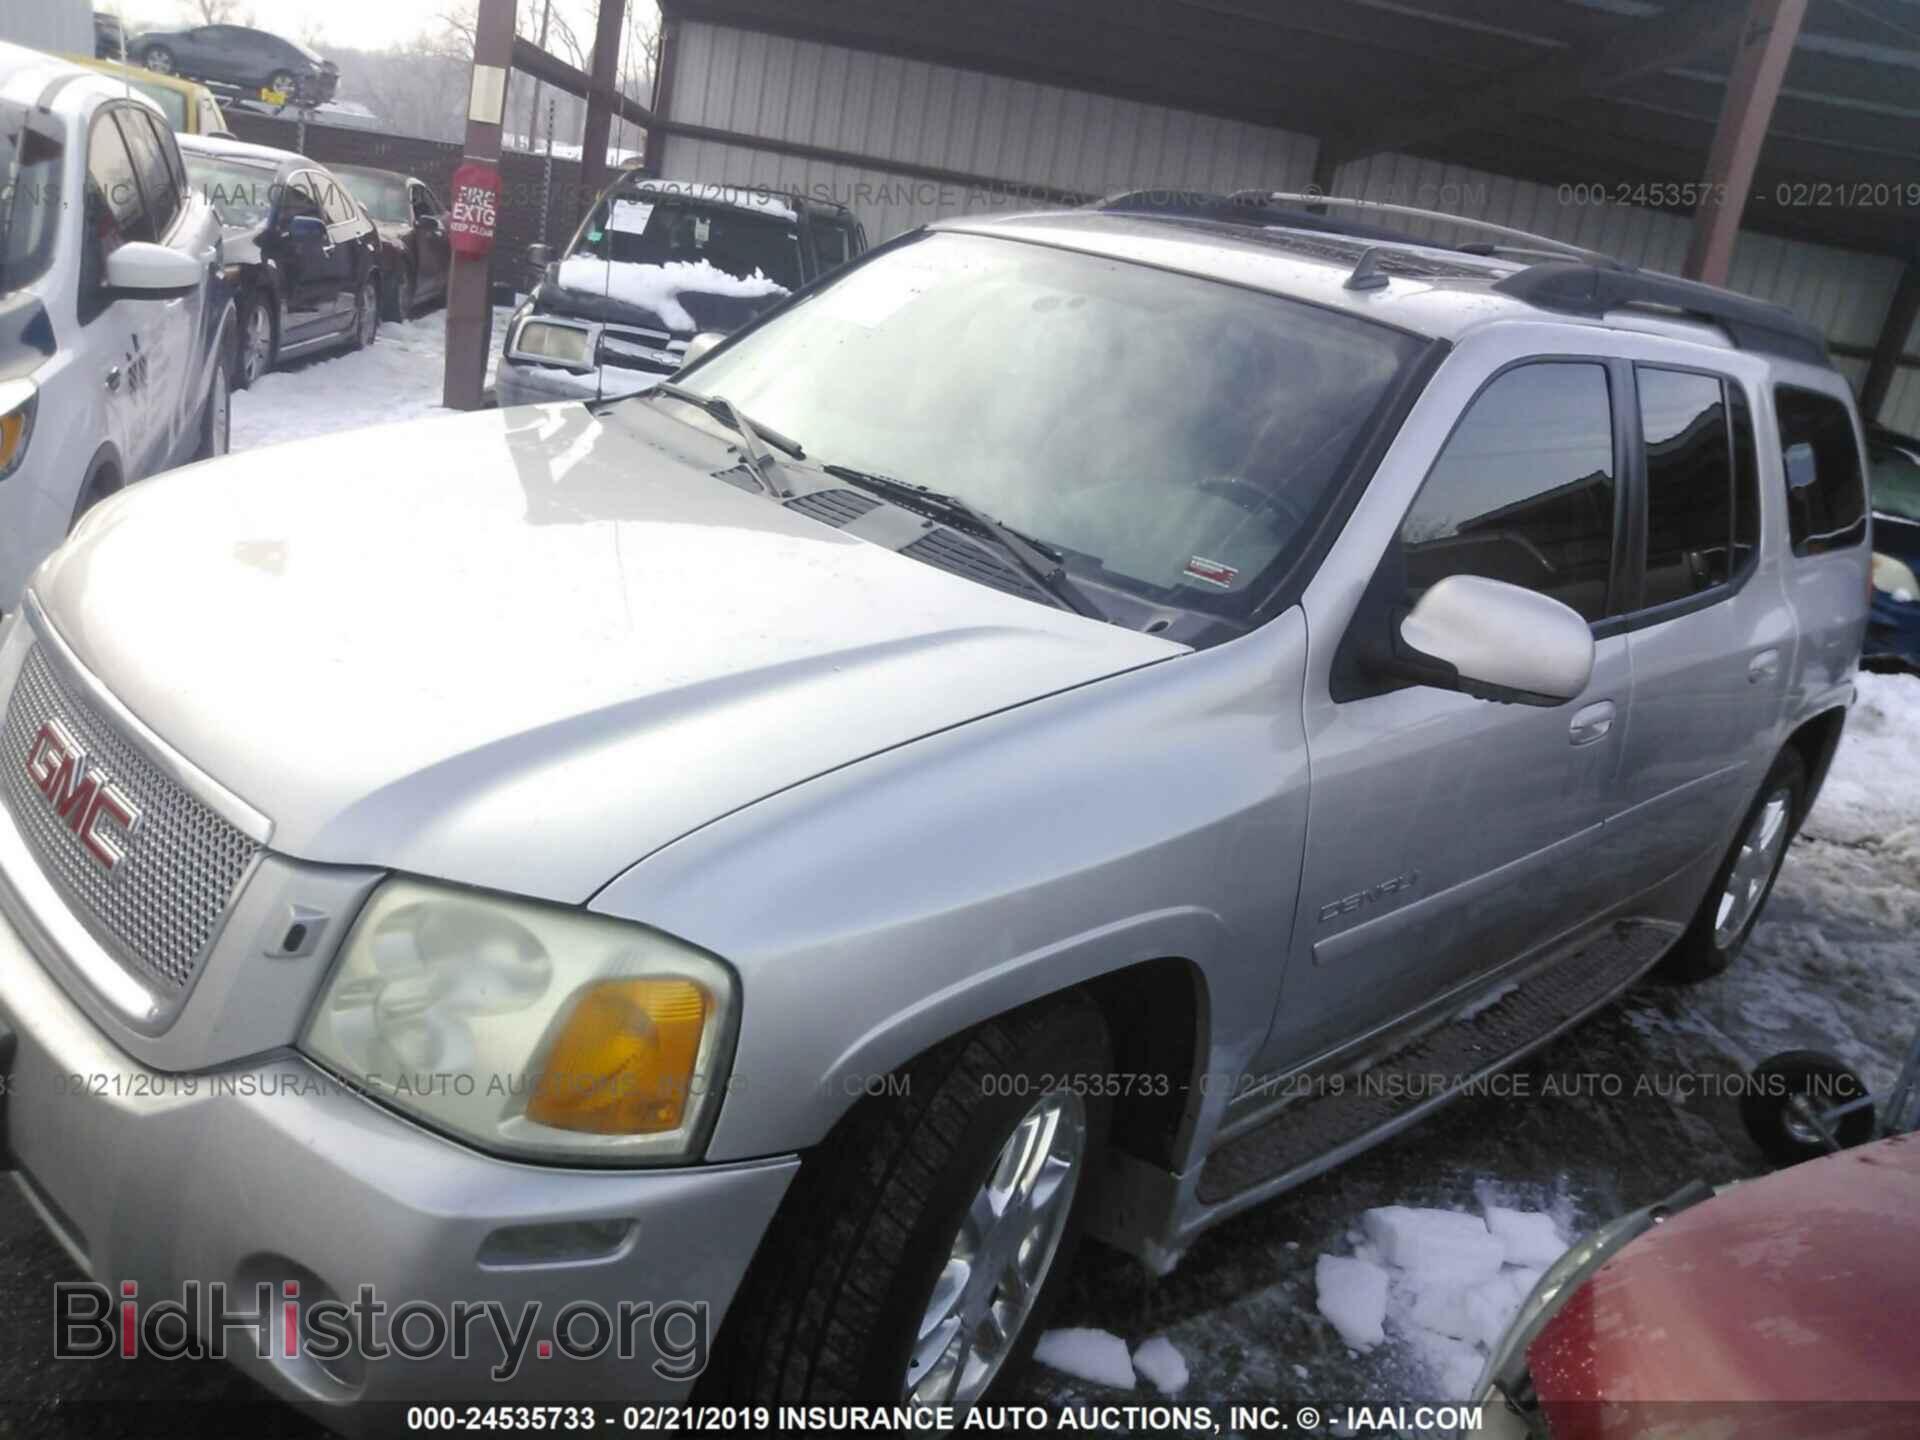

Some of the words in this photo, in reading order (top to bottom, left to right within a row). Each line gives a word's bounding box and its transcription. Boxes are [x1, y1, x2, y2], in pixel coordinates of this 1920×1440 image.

[459, 186, 495, 209] FIRE
[452, 202, 496, 227] EXTG
[26, 717, 143, 870] GMC
